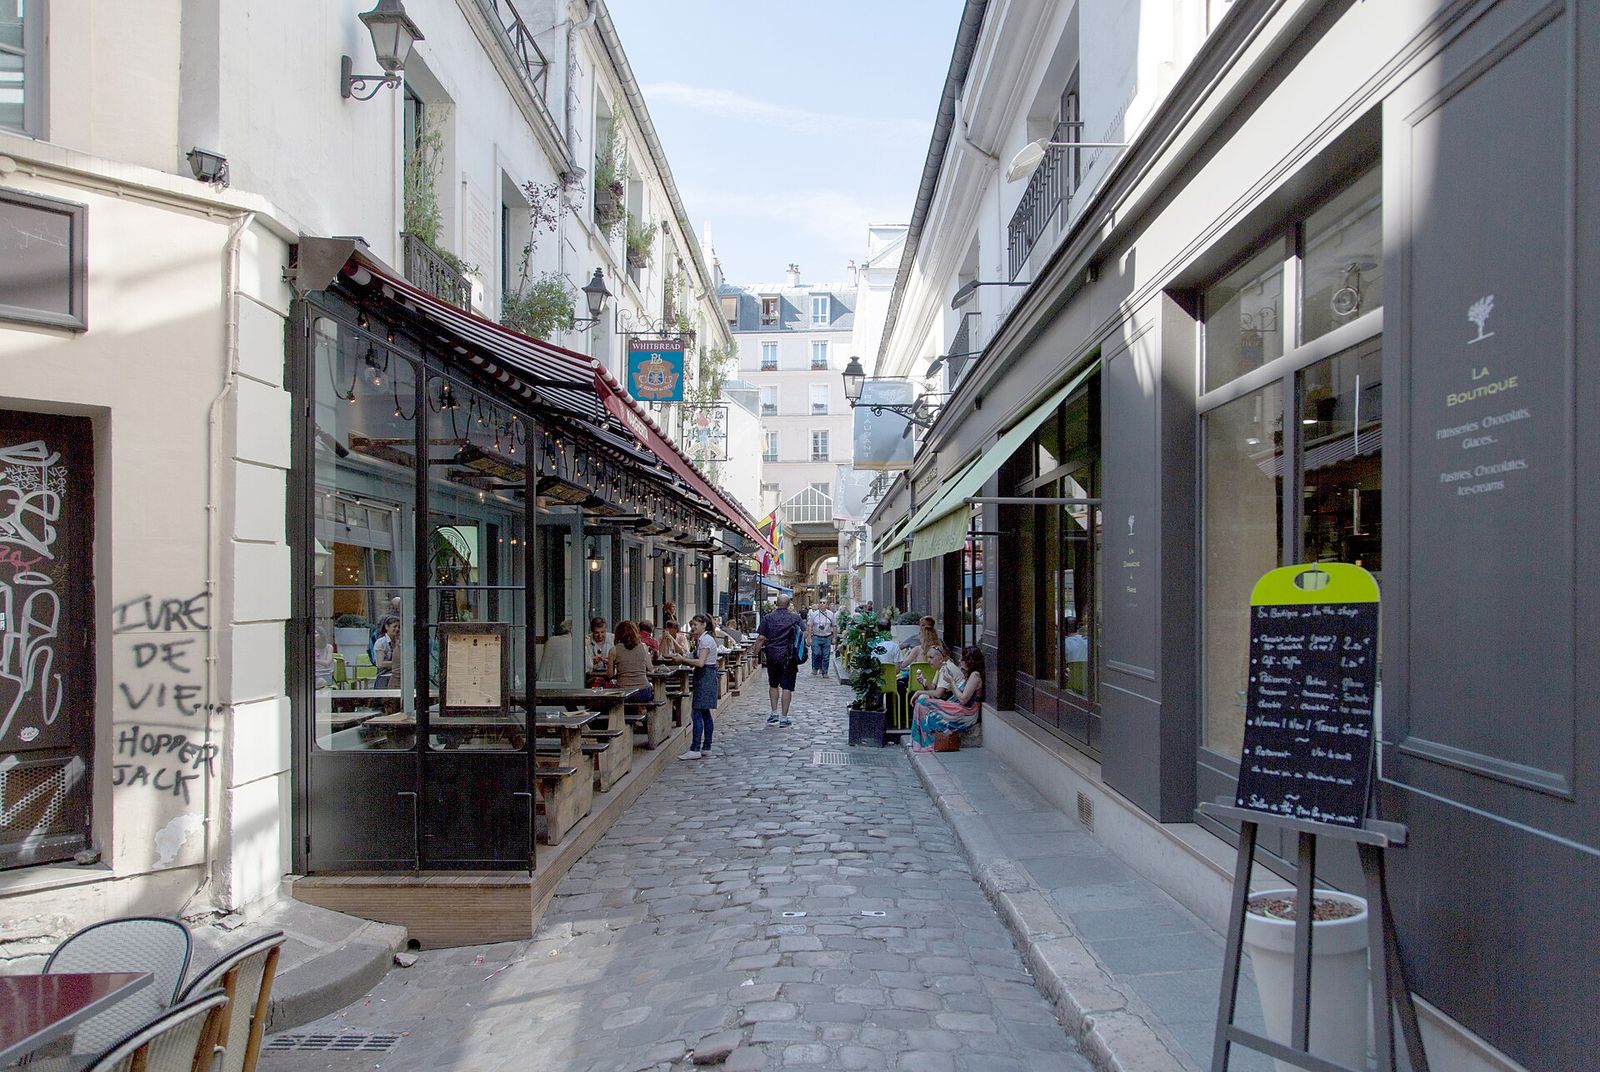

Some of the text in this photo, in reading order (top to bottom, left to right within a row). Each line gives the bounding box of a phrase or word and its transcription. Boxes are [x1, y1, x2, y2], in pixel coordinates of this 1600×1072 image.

[632, 342, 681, 350] WHITBREAD
[1472, 367, 1489, 381] LA
[1446, 376, 1519, 407] BOUTIQUE
[132, 639, 195, 673] DE
[118, 725, 218, 778] HOPPER
[112, 764, 199, 805] JACK
